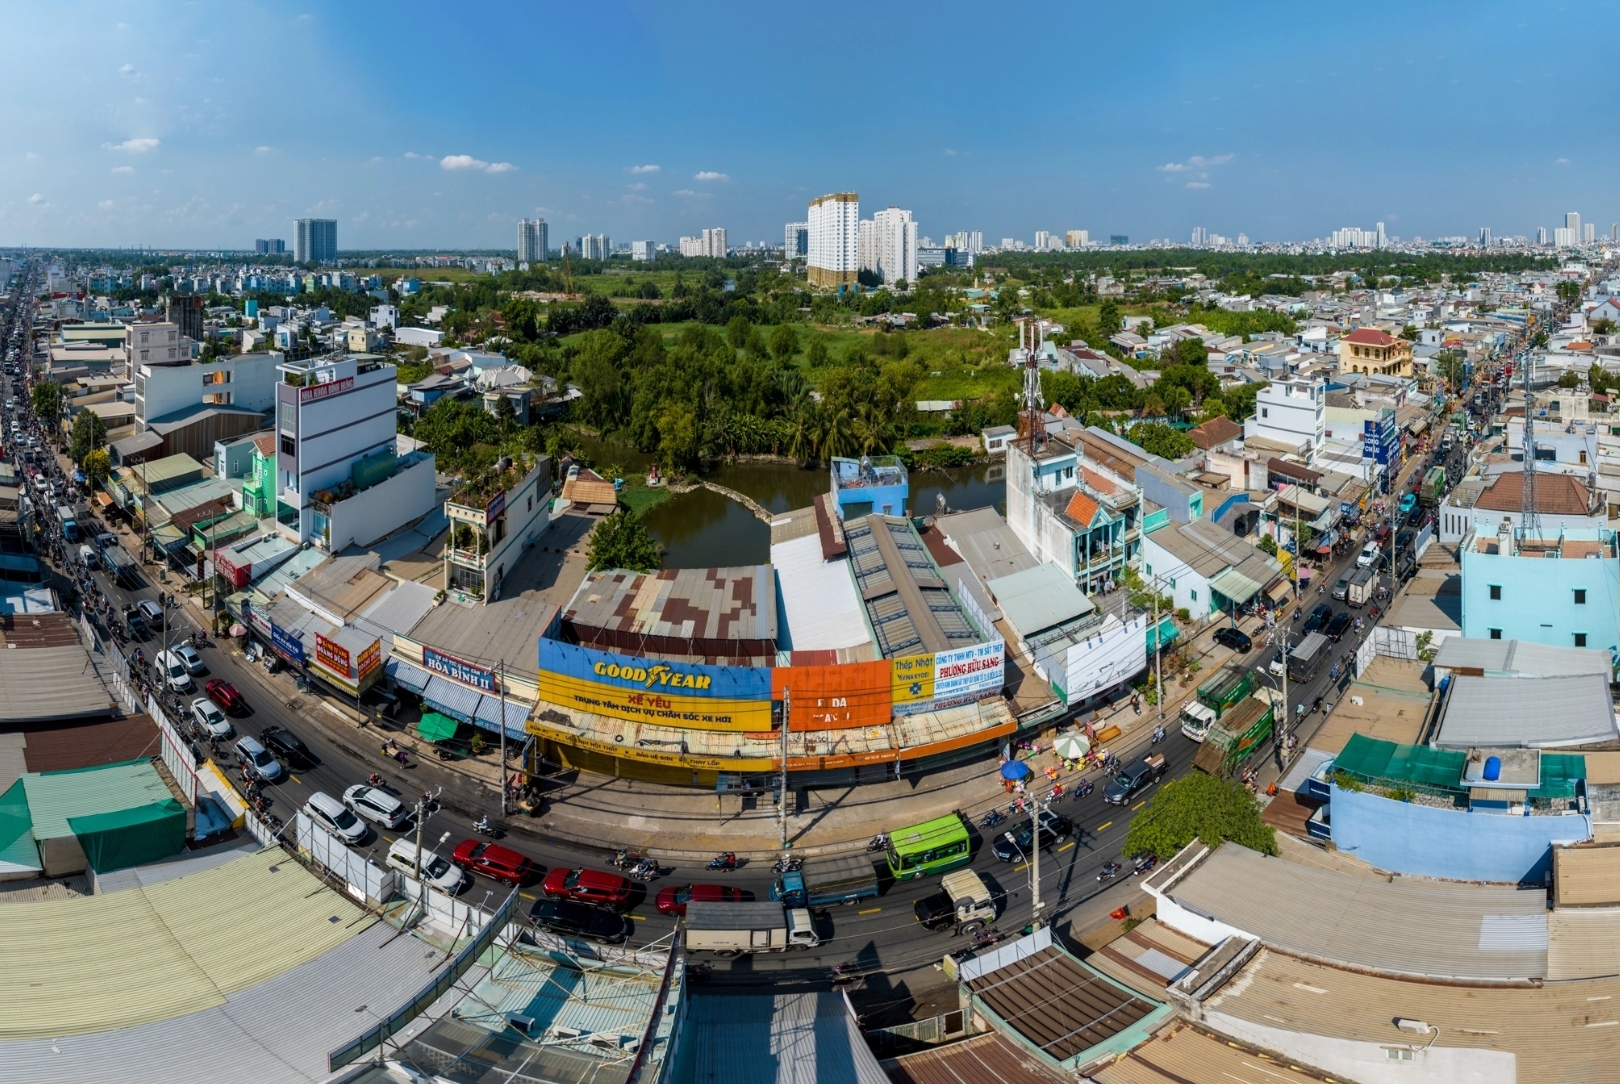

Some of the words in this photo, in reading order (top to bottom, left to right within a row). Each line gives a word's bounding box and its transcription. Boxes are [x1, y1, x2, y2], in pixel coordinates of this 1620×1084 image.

[428, 658, 449, 674] HÒA
[451, 668, 478, 685] BÌNH
[895, 660, 912, 671] Thép
[916, 657, 933, 668] Nhật
[940, 663, 966, 678] PHƯƠNG
[982, 657, 999, 670] SANG
[574, 695, 600, 706] TRUNG
[602, 700, 619, 710] TÂM
[621, 705, 641, 714] DỊCH
[644, 709, 654, 717] VỤ
[657, 710, 681, 719] CHĂM
[683, 712, 699, 721] SÓC
[647, 695, 671, 709] YÊU
